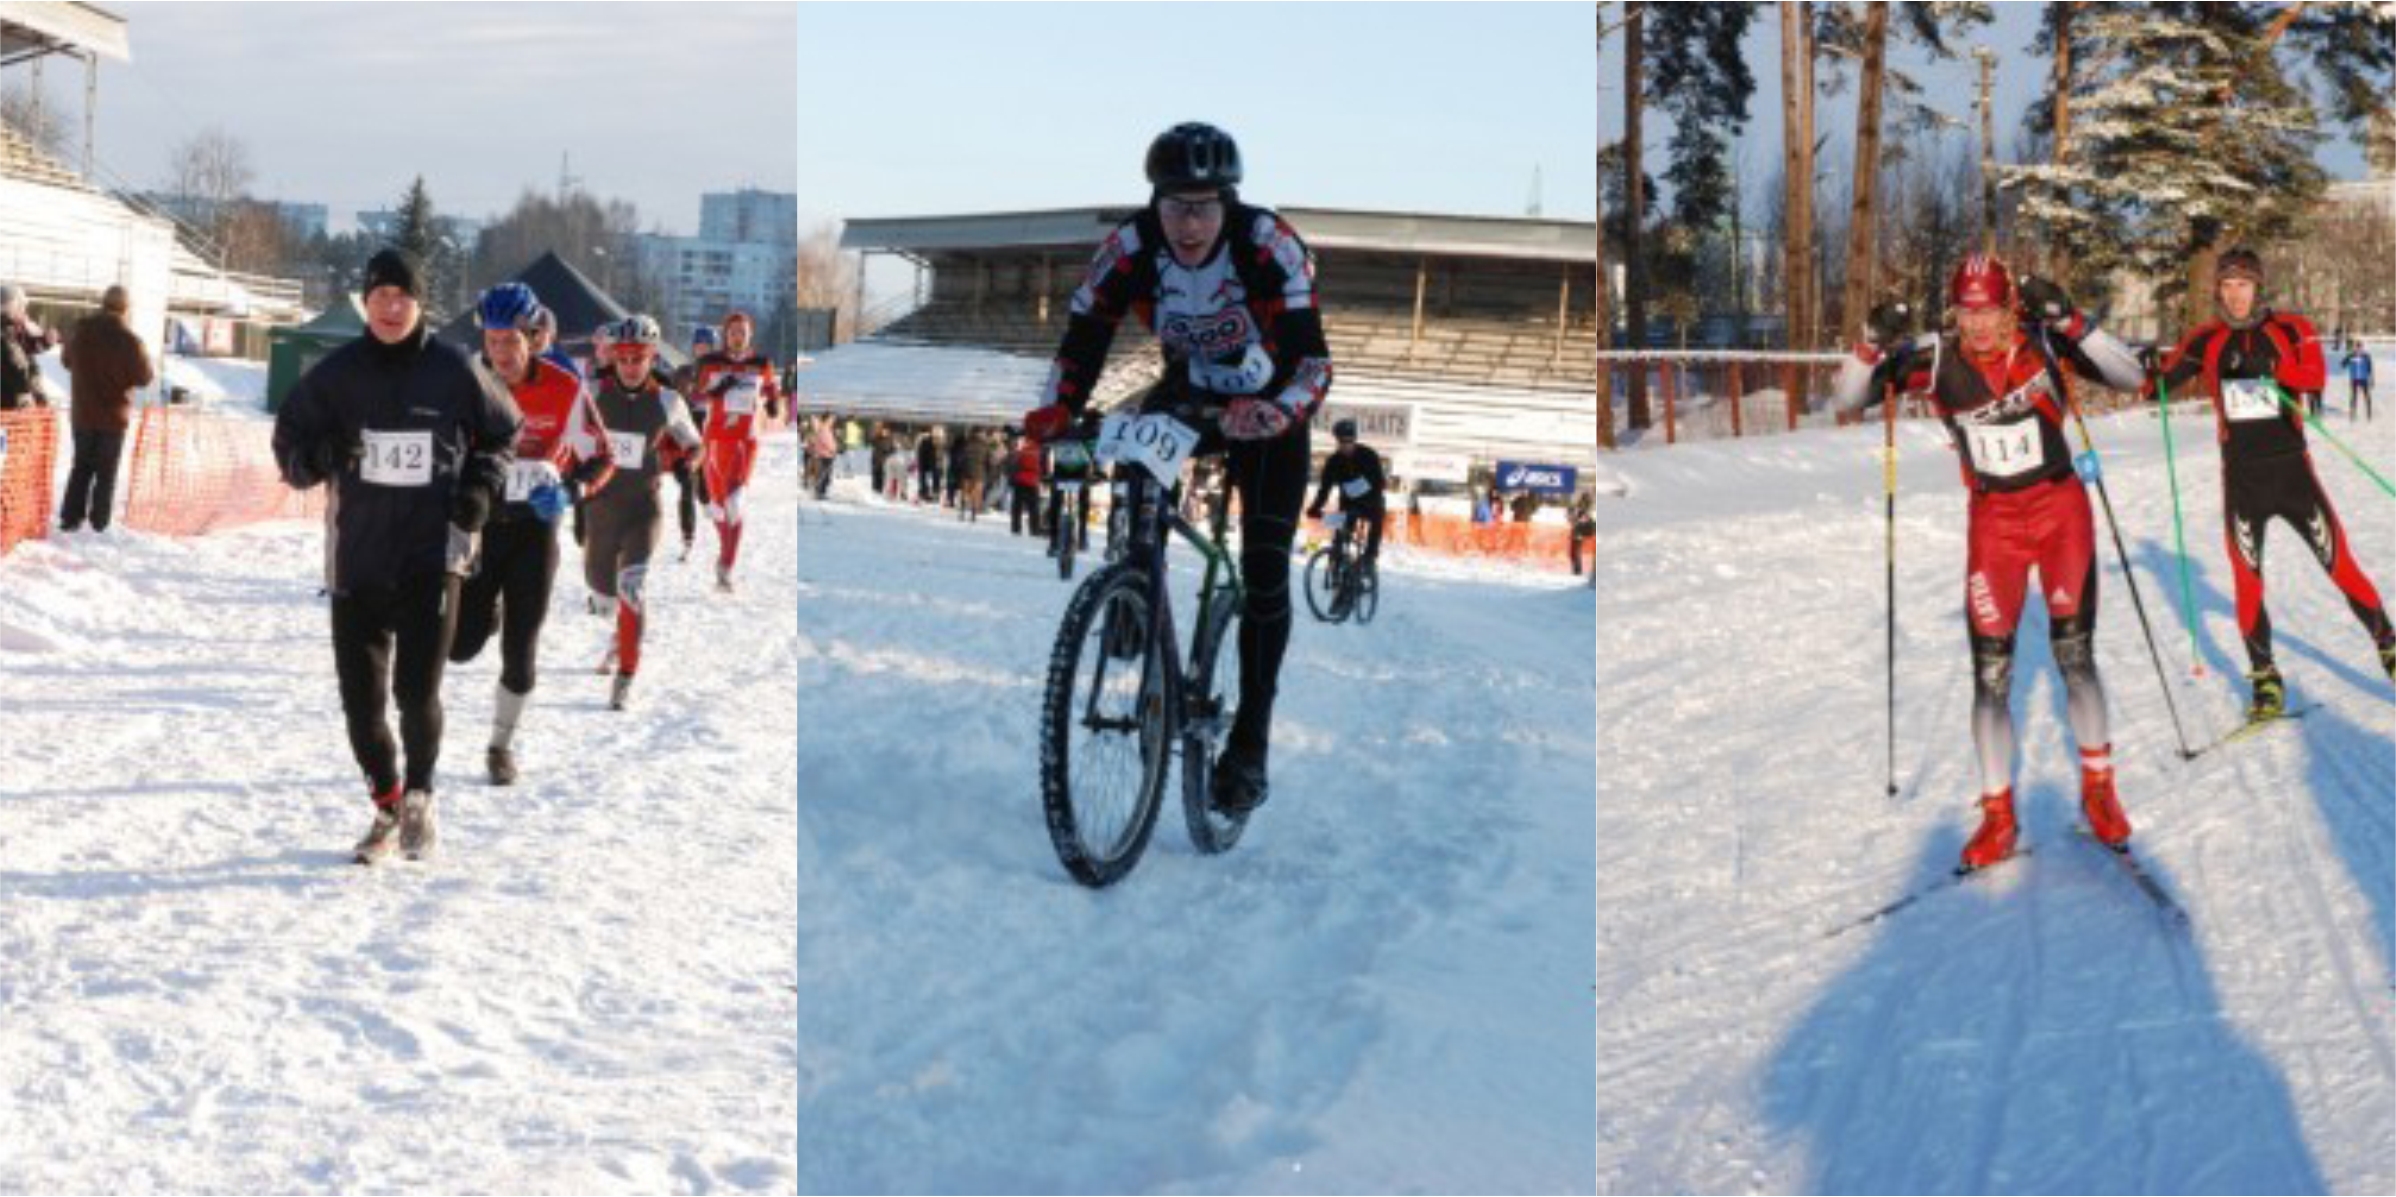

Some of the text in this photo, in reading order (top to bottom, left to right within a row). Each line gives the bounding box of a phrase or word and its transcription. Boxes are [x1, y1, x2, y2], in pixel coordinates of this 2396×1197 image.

[1115, 420, 1178, 463] 109
[1979, 434, 2030, 461] 114
[370, 442, 422, 470] 142
